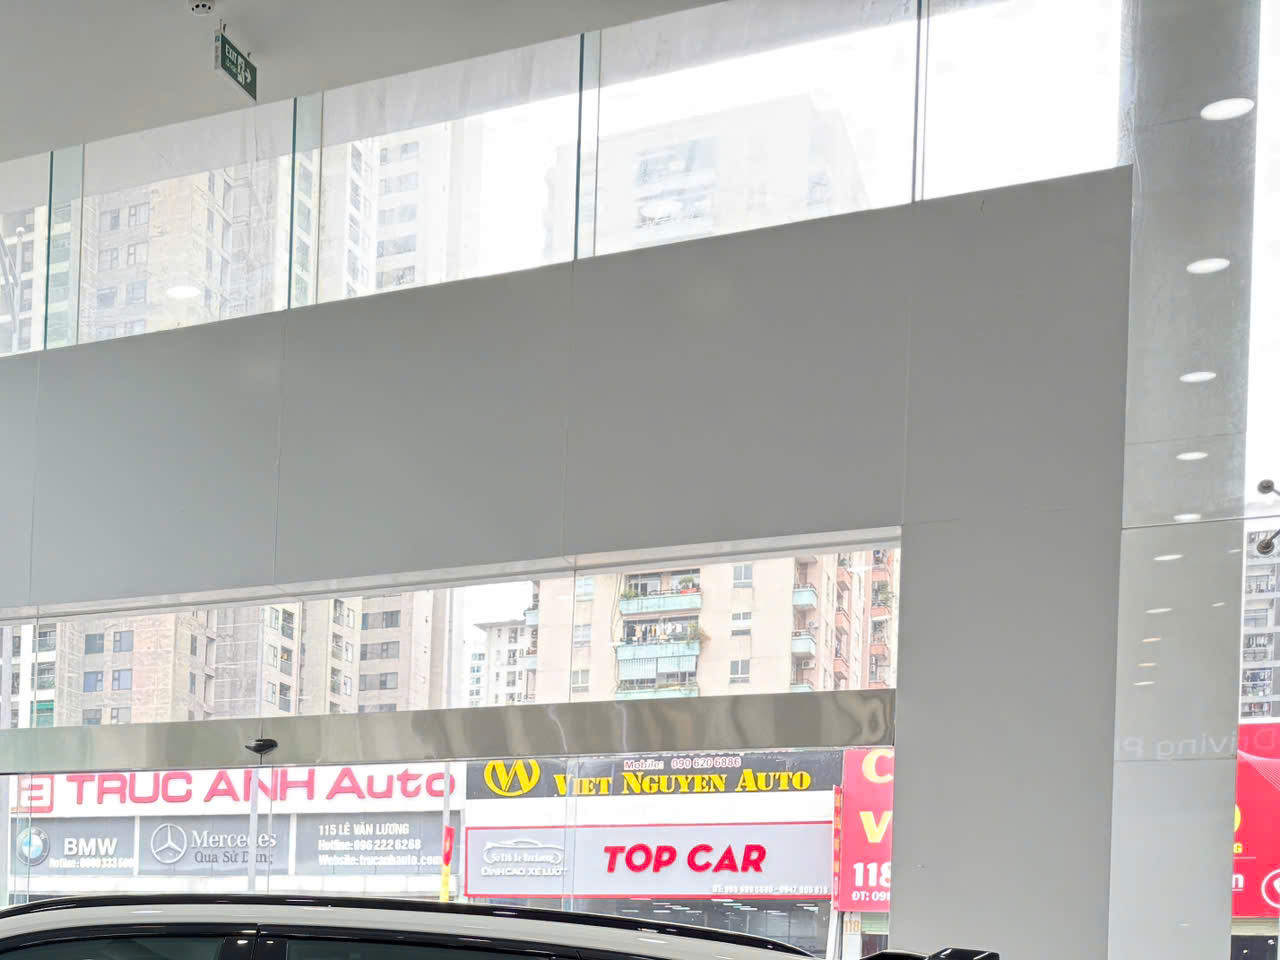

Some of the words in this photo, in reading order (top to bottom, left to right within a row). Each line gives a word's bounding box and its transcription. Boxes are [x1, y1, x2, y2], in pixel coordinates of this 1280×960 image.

[624, 760, 664, 770] Mobile:
[671, 758, 691, 769] 090
[693, 758, 713, 769] 620
[714, 757, 742, 768] 6886
[66, 770, 192, 804] TRUC
[203, 768, 315, 802] ANH
[326, 766, 455, 800] Auto
[621, 771, 727, 795] NGUYEN
[735, 768, 812, 792] AUTO
[319, 824, 337, 835] 115
[338, 821, 350, 835] LÊ
[353, 820, 374, 835] VĂN
[64, 837, 118, 856] BMW
[354, 839, 373, 851] 096
[374, 839, 394, 851] 222
[194, 850, 219, 864] Qua
[222, 849, 239, 864] Sử
[603, 843, 678, 873] TOP
[687, 843, 767, 873] CAR
[871, 890, 891, 902] 09
